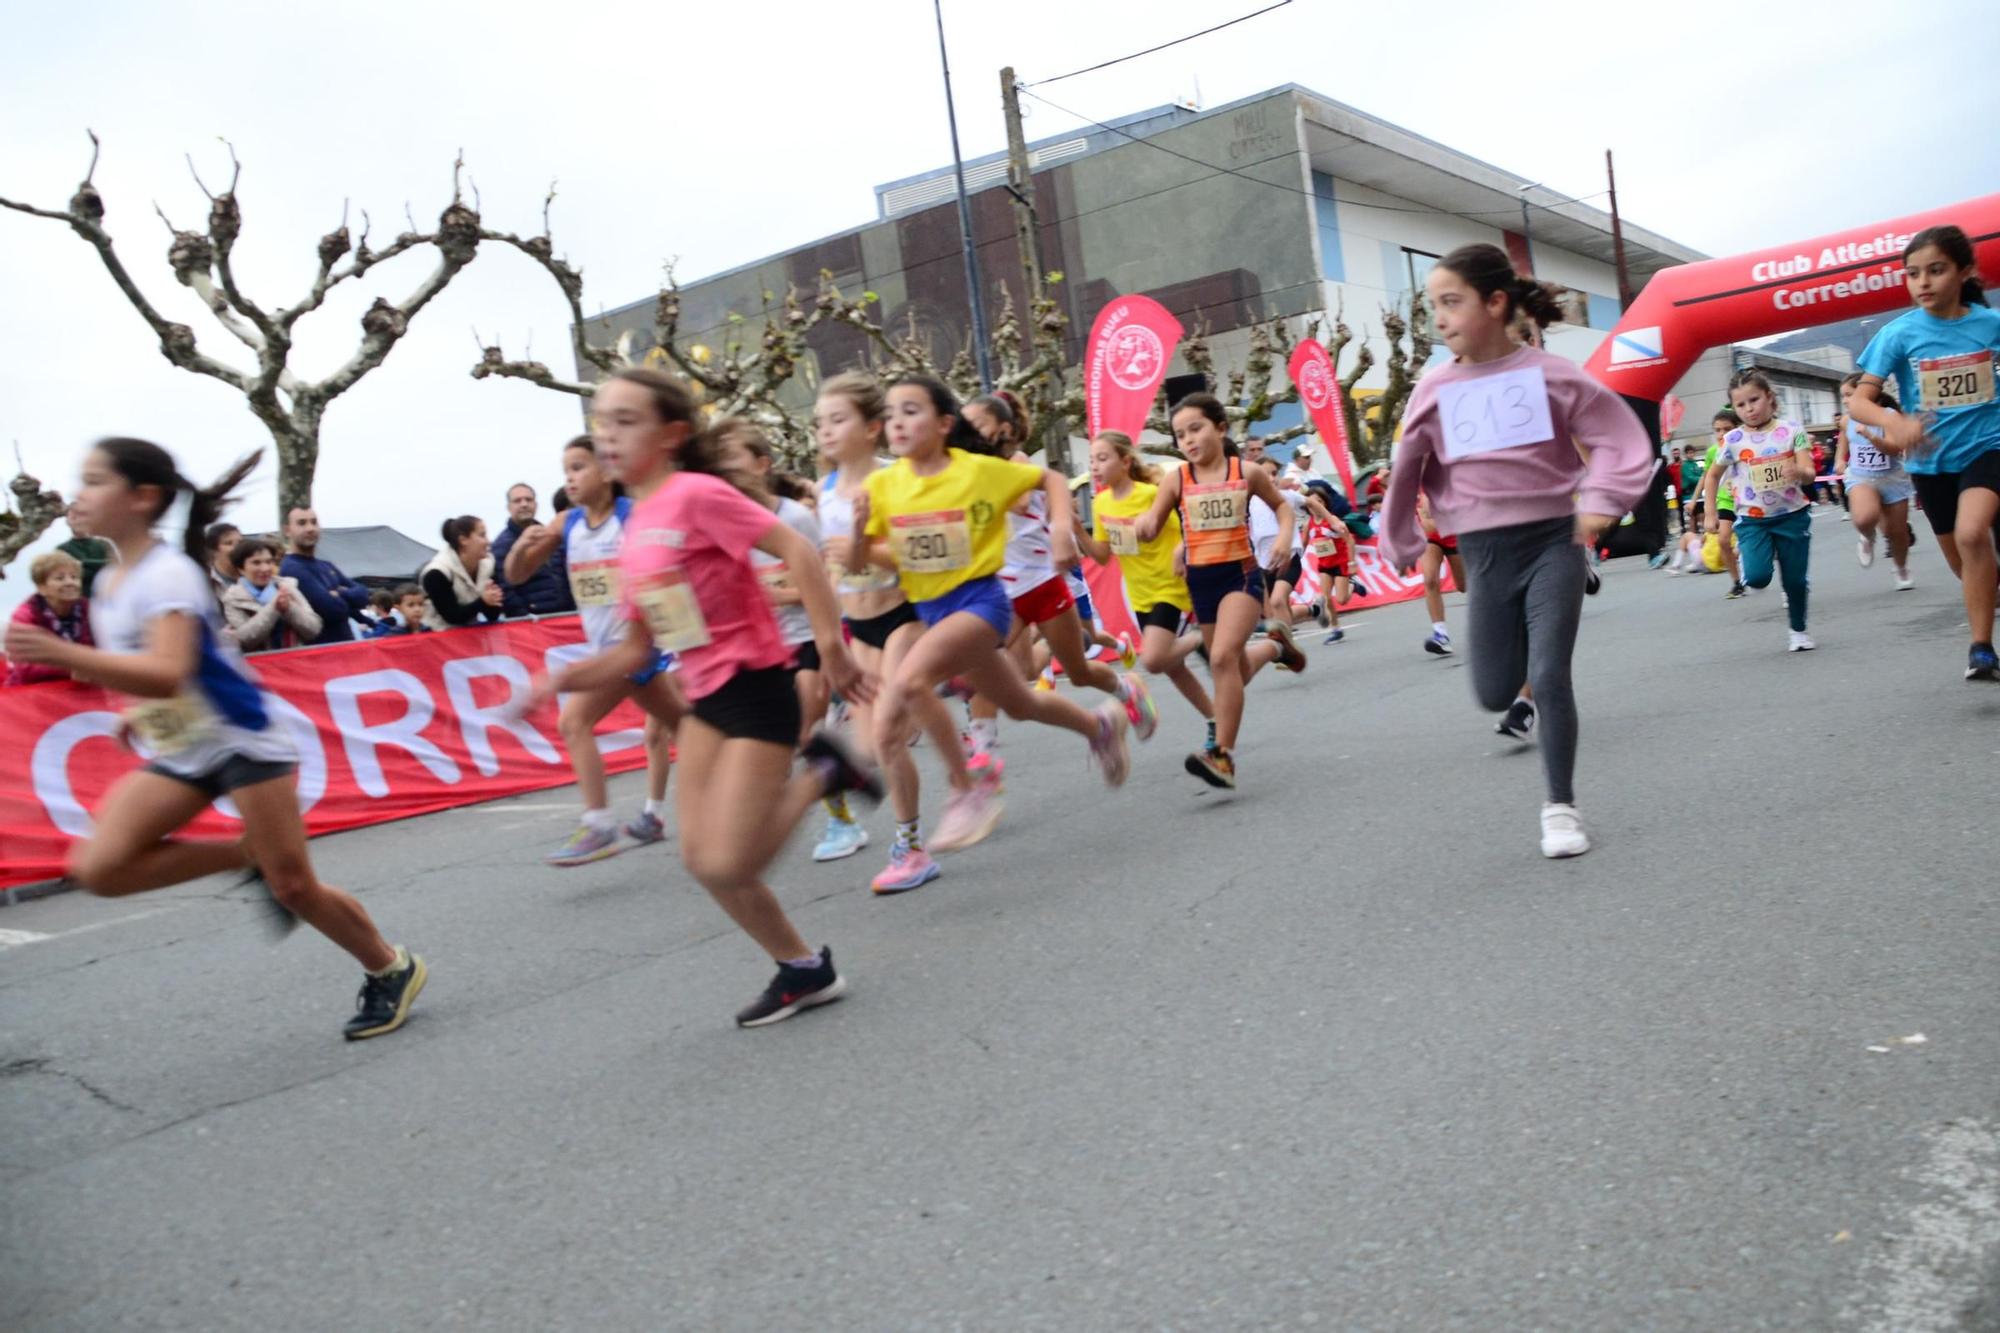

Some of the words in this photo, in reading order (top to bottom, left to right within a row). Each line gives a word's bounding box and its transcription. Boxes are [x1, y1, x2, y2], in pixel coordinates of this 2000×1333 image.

[1752, 254, 1812, 282] Club
[1101, 305, 1129, 339] BUEU
[1937, 371, 1978, 398] 320
[1451, 384, 1536, 445] 613
[1199, 498, 1233, 520] 303
